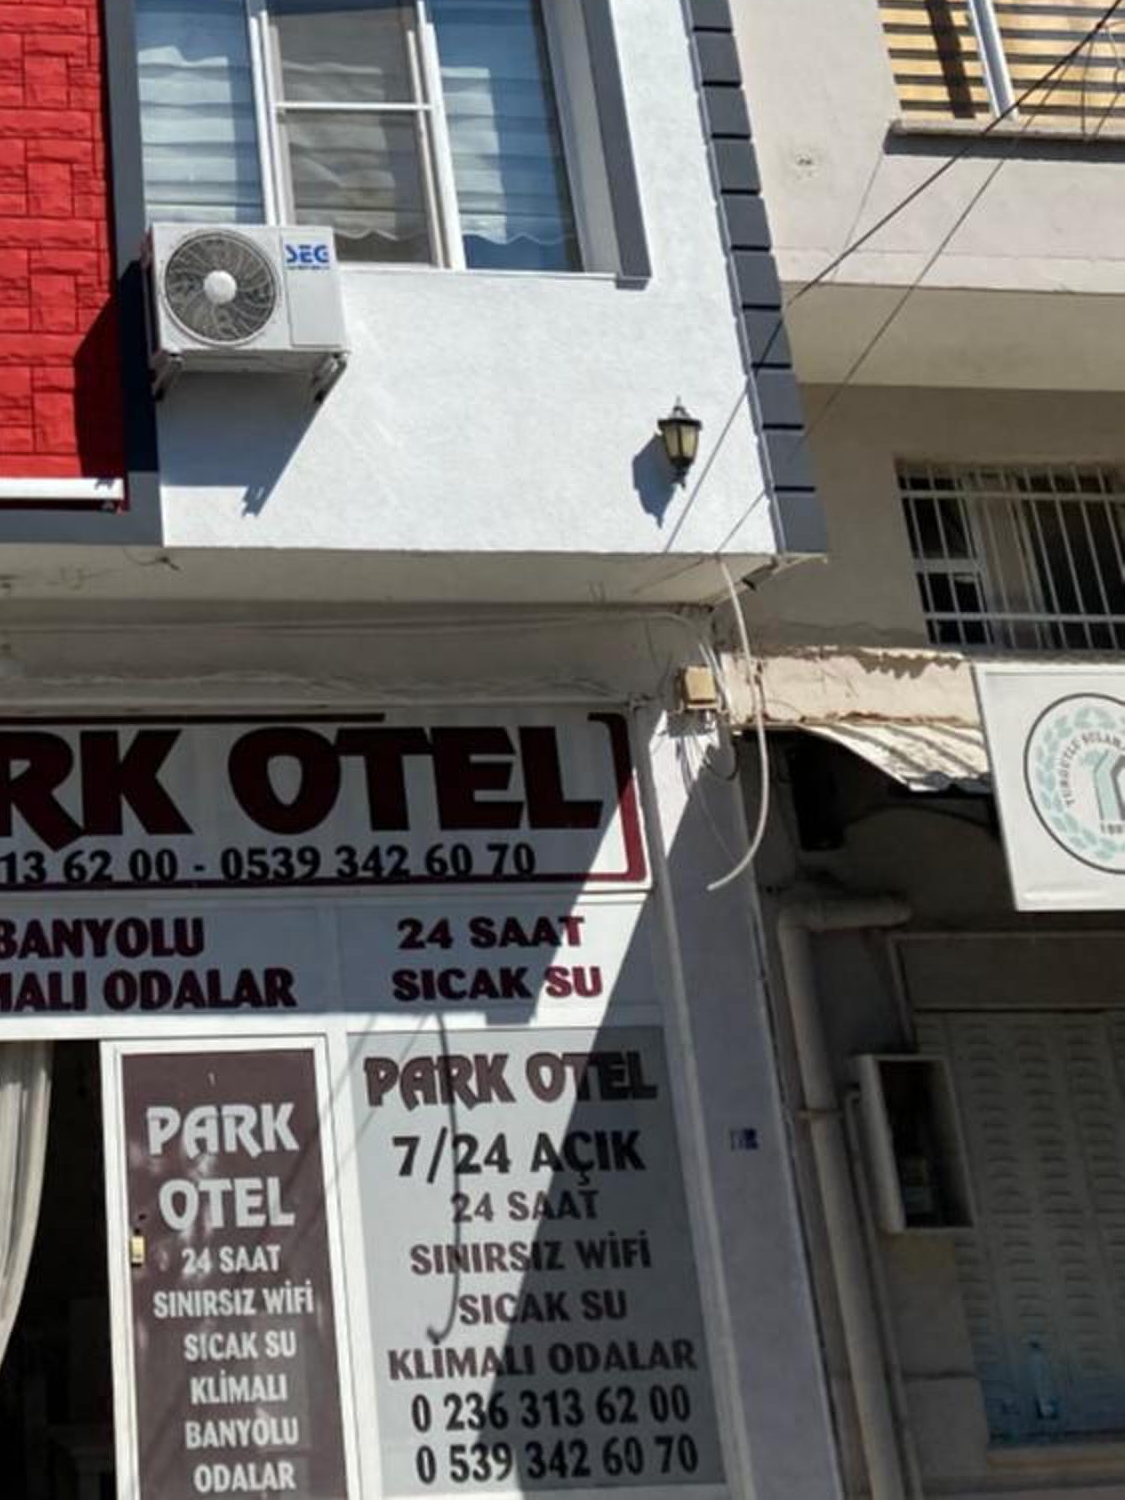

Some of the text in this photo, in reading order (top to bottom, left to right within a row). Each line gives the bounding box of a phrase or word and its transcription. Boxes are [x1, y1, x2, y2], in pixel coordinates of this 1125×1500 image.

[285, 244, 329, 263] SEG
[227, 726, 603, 836] OTEL
[63, 850, 113, 883] 62
[129, 849, 177, 883] 00
[221, 844, 321, 881] 0539
[336, 843, 411, 879] 342
[425, 843, 473, 878] 60
[486, 841, 536, 877] 70
[397, 916, 585, 949] 24 SAAT
[103, 968, 297, 1011] ODALAR
[393, 965, 603, 1001] SICAK SU
[364, 1051, 659, 1111] PARK OTEL
[146, 1103, 300, 1160] PARK
[392, 1126, 647, 1186] 7/24 AÇIK
[158, 1176, 296, 1231] OTEL
[452, 1189, 599, 1224] 24 SAAT
[181, 1245, 281, 1275] 24 SAAT
[409, 1229, 652, 1276] SINIRSIZ WİFİ
[152, 1279, 315, 1319] SINIRSIZ WİFİ
[457, 1289, 628, 1325] SICAK SU
[183, 1330, 296, 1362] SICAK SU
[387, 1338, 698, 1381] KLİMALI ODALAR
[189, 1369, 288, 1406] KLİMALI
[411, 1383, 691, 1433] 0 236 313 62 00
[184, 1416, 300, 1451] BANYOLU
[193, 1462, 296, 1494] ODALAR
[415, 1433, 699, 1484] 0 539 342 60 70
